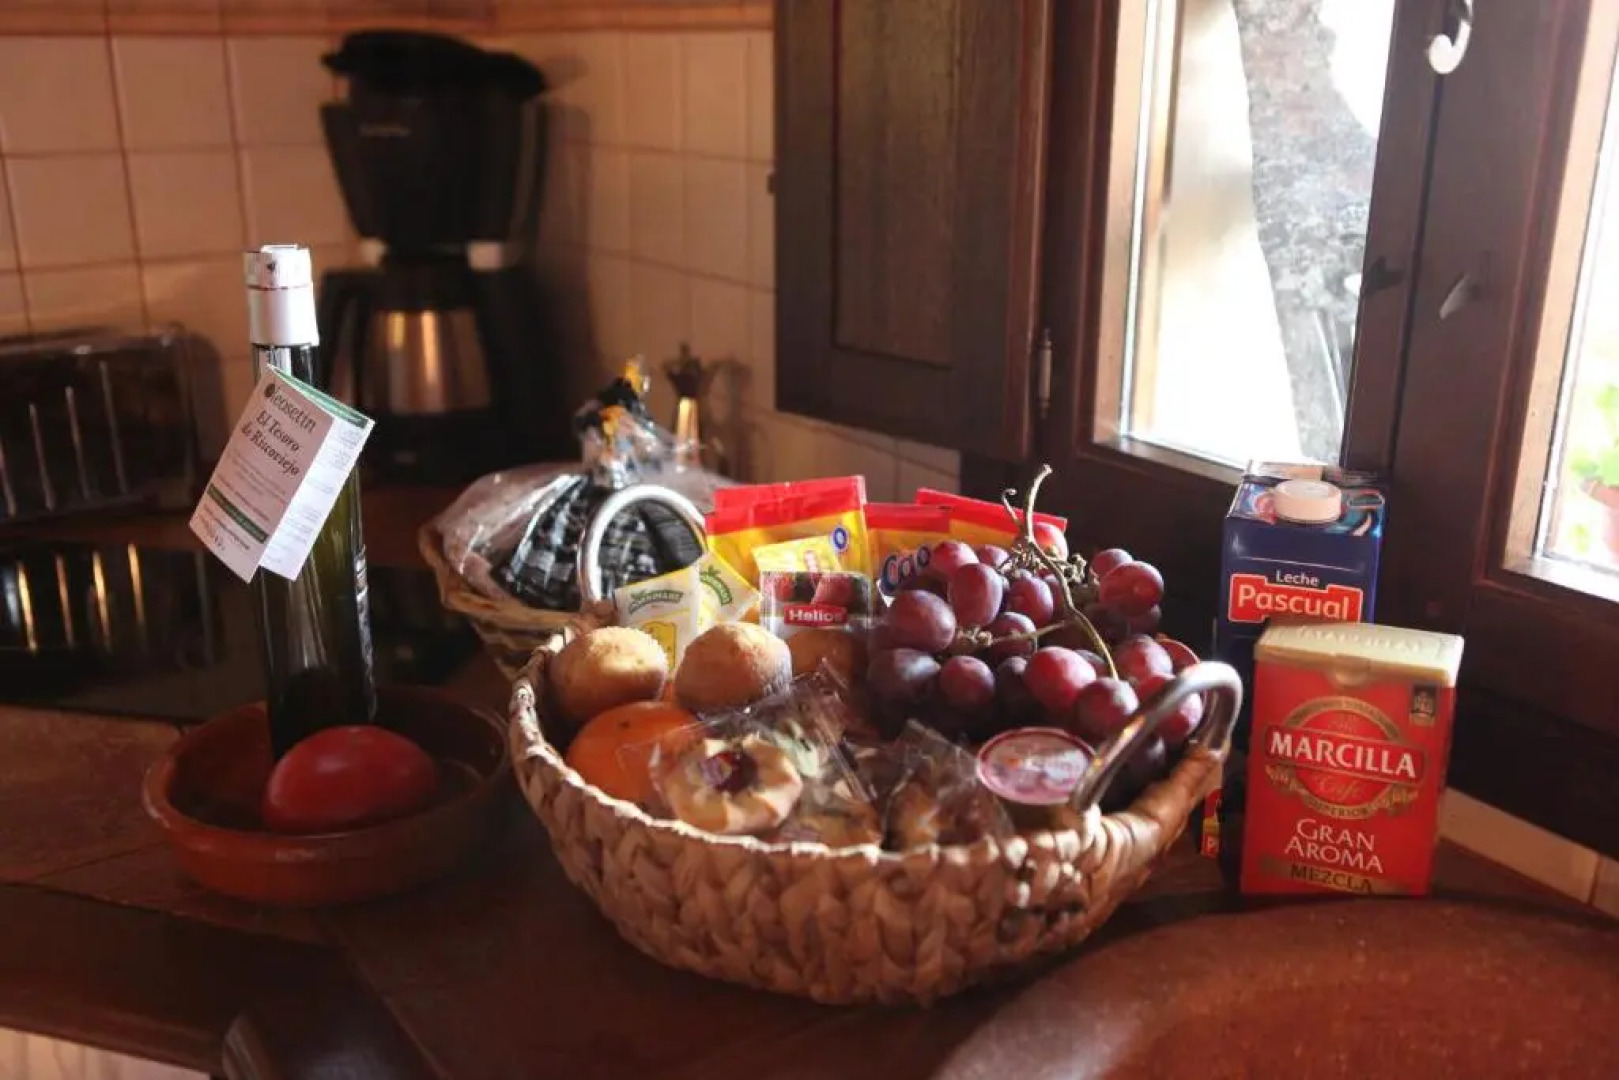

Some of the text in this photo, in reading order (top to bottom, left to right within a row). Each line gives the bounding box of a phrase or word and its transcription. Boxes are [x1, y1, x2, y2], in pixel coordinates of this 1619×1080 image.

[269, 418, 300, 452] Tesoro
[881, 545, 932, 597] Cao
[1276, 569, 1320, 586] Leche
[1238, 583, 1350, 621] Pascual
[1270, 731, 1416, 779] MARCILLA
[1297, 818, 1375, 851] GRAN
[1284, 835, 1383, 873] AROMA
[1291, 864, 1373, 894] MEZCLA
